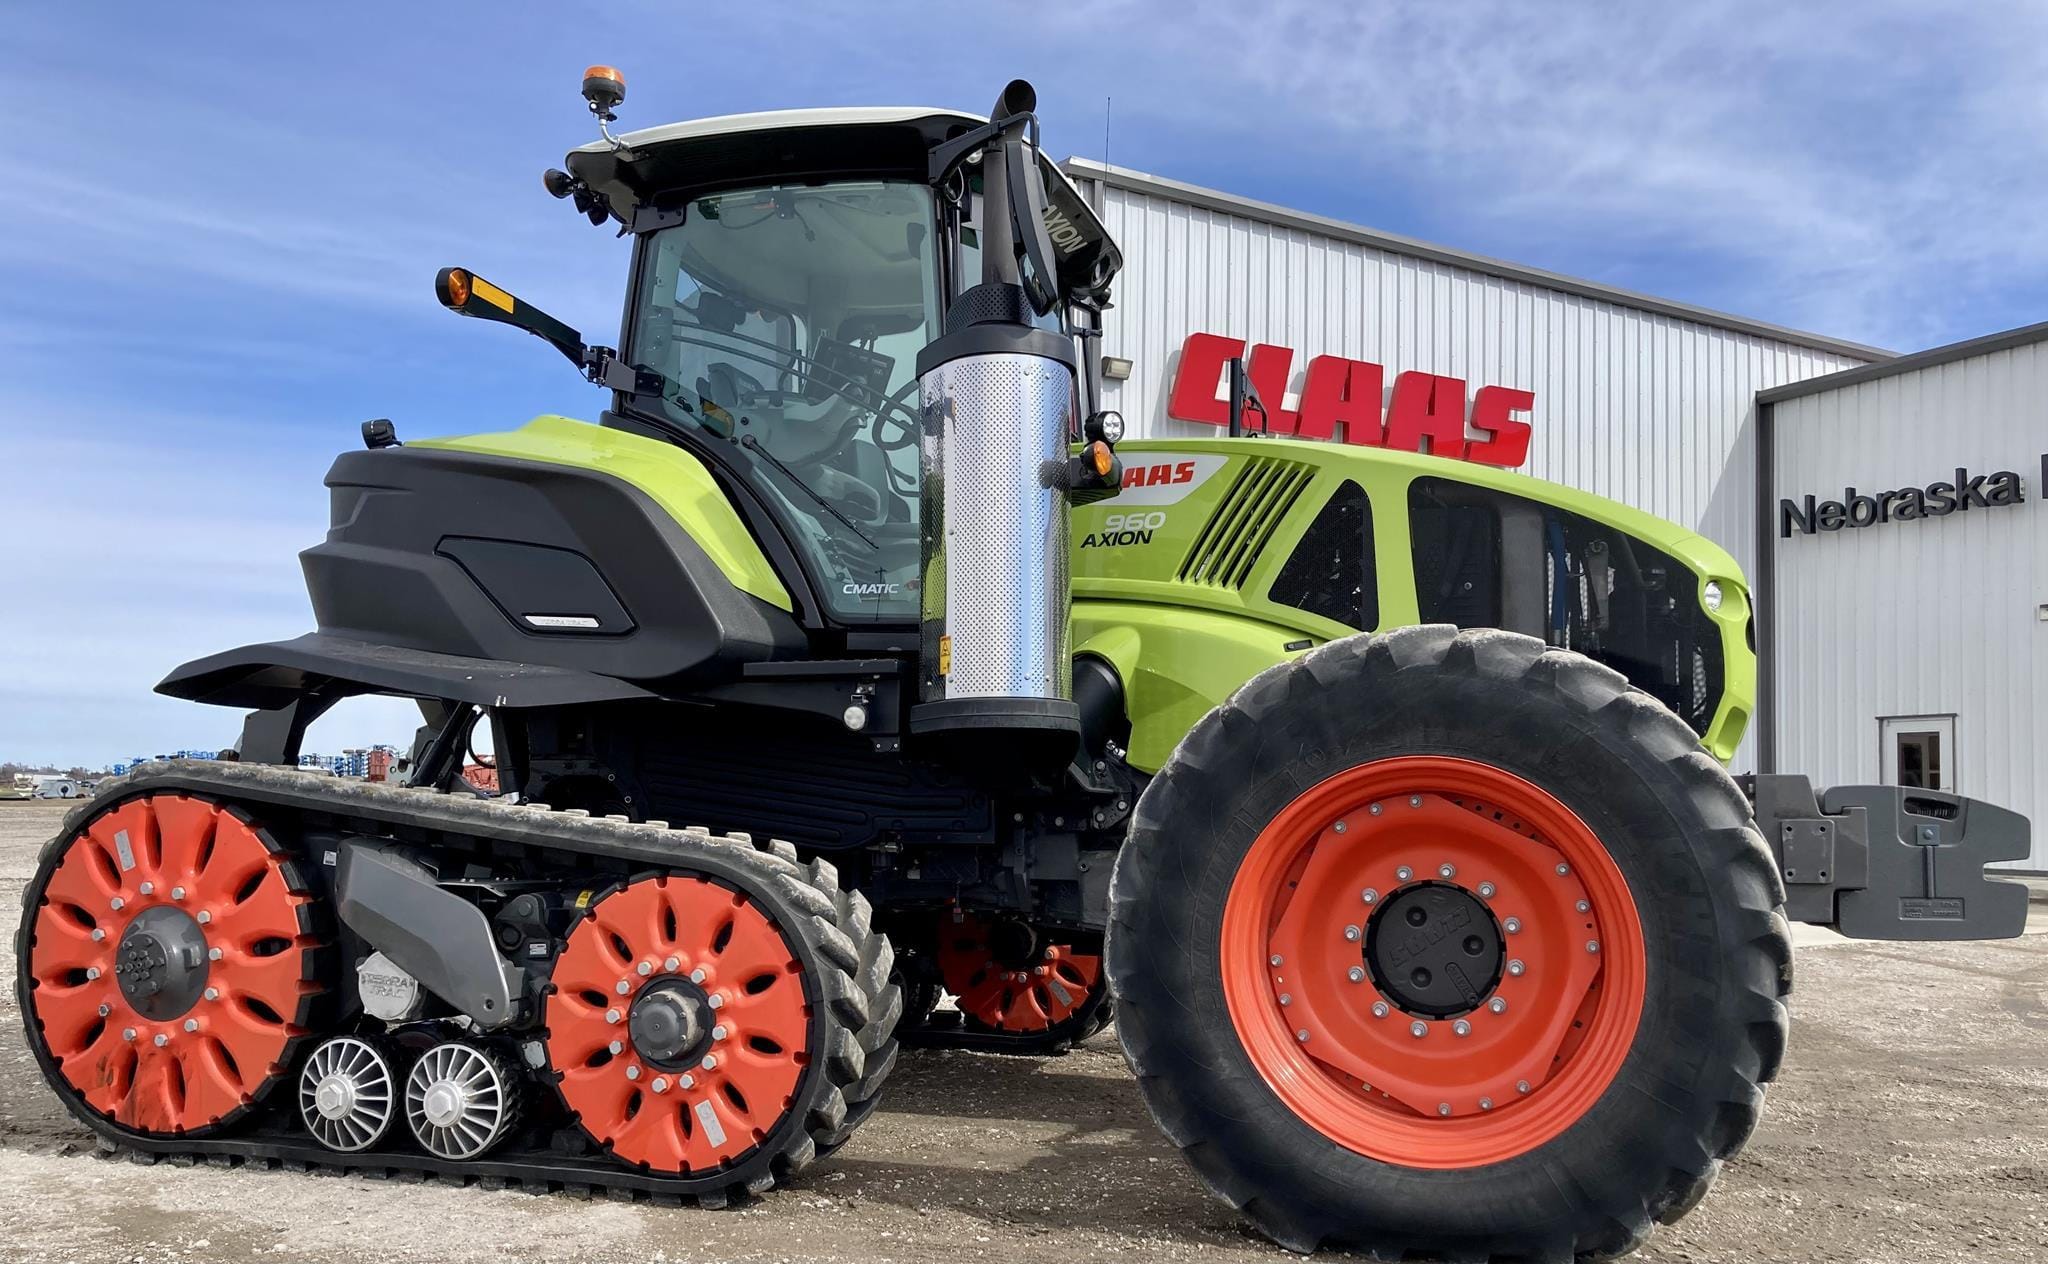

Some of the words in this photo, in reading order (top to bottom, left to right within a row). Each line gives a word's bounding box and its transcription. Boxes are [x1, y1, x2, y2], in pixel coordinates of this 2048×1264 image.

[1168, 332, 1535, 467] CLAAS
[1122, 462, 1195, 488] AAS
[1781, 467, 2025, 538] Nebraska
[1105, 512, 1166, 532] 960
[1080, 530, 1153, 548] AXION
[843, 583, 899, 594] CMATIC
